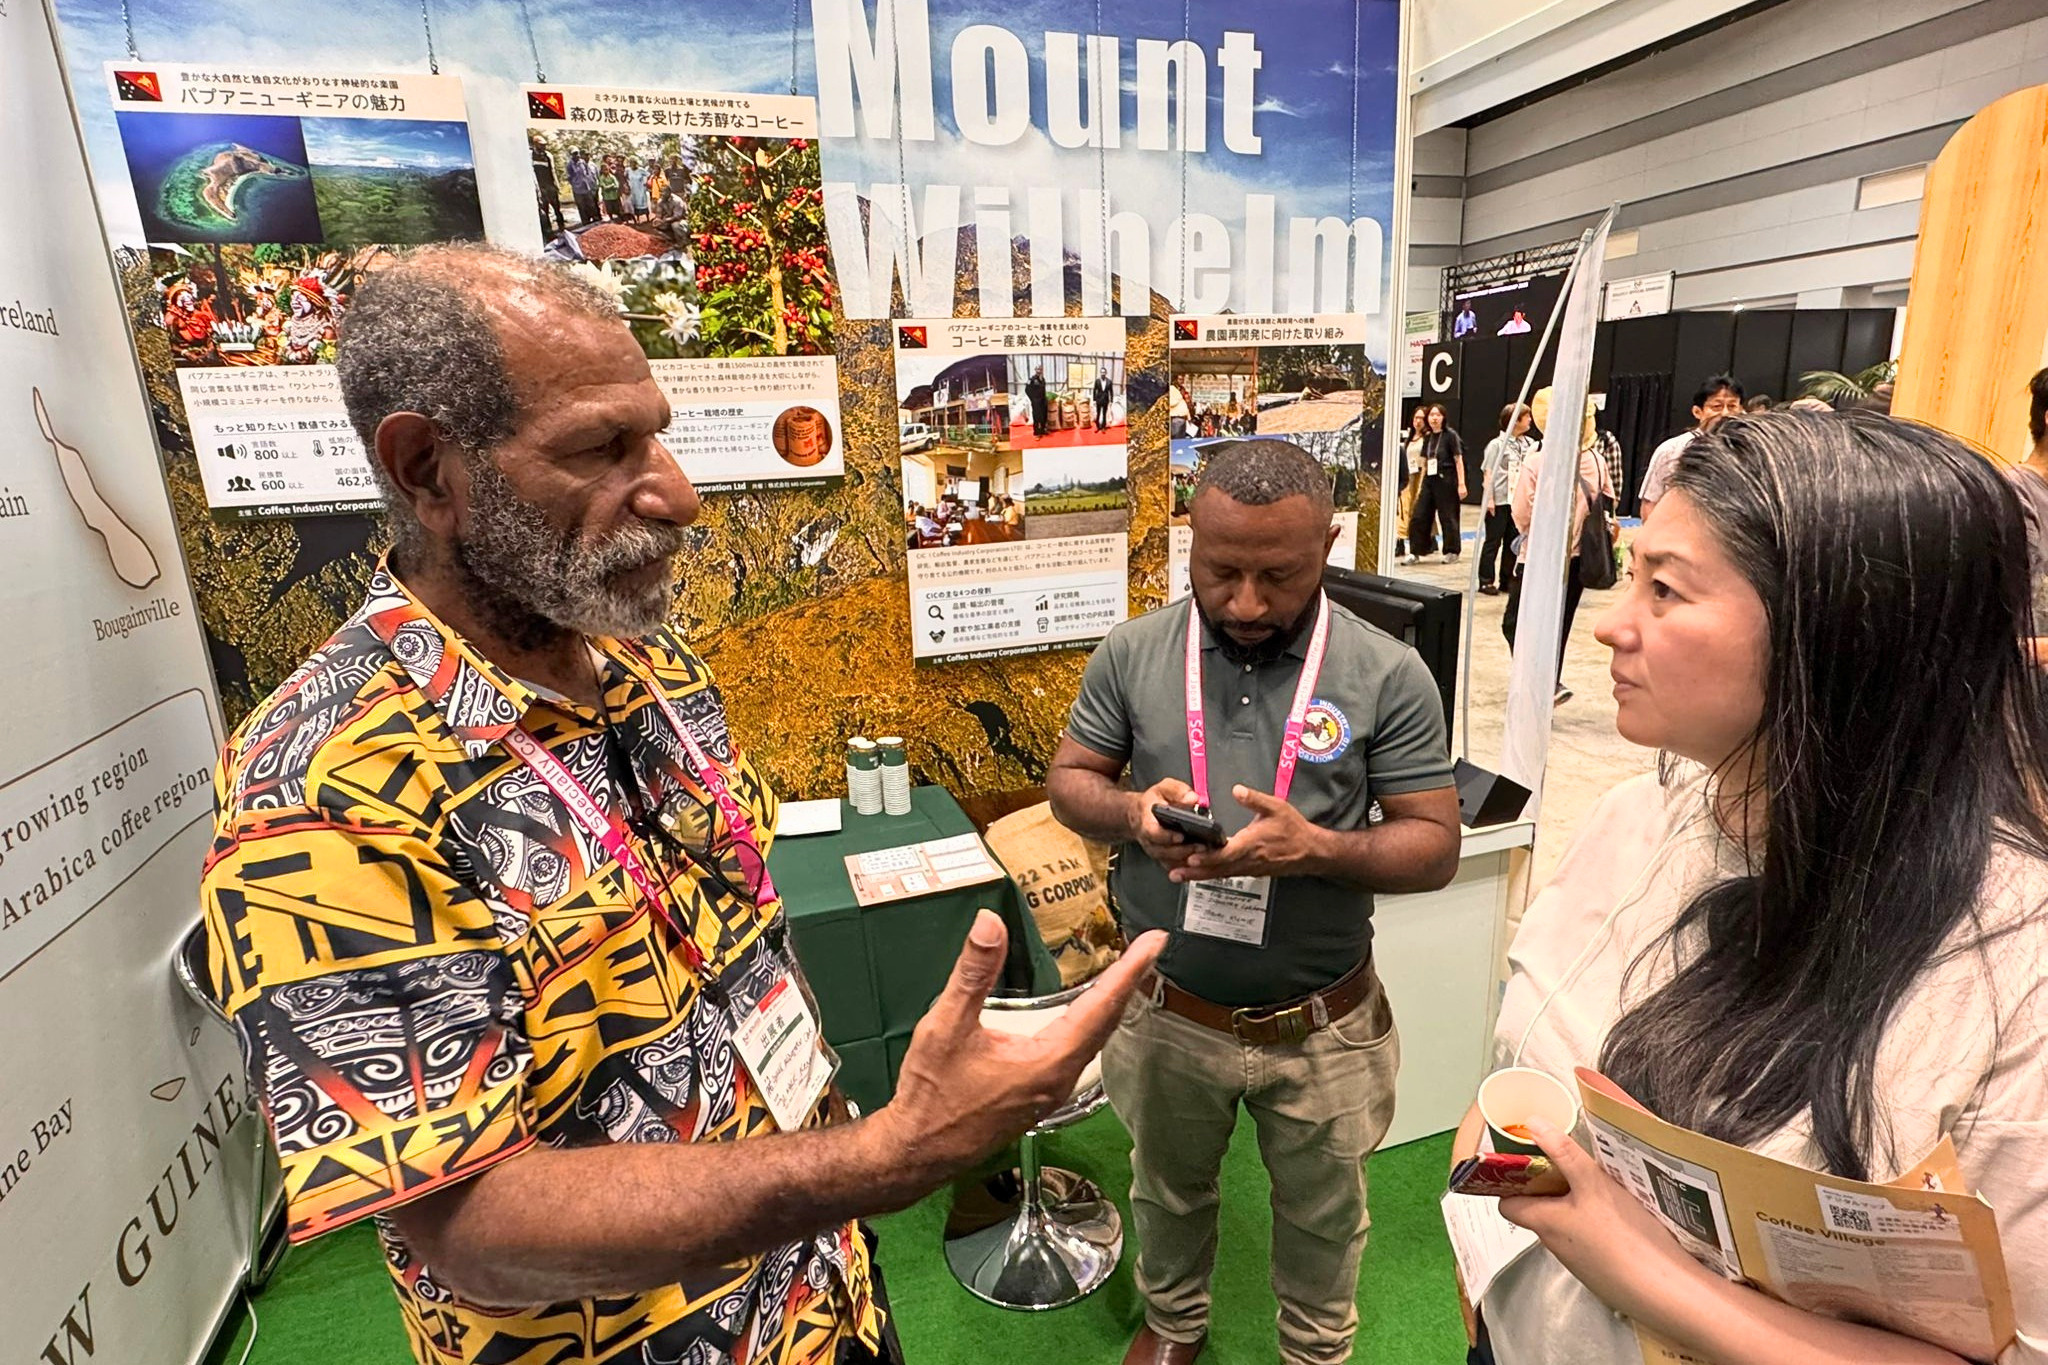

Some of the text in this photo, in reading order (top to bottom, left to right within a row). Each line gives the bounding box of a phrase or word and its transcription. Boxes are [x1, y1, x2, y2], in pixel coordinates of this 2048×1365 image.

[812, 0, 1262, 155] Mount
[181, 87, 406, 112] パプアニューギニアの魅力
[570, 106, 805, 130] 森の恵みを受けた芳醇なコーヒー
[820, 181, 1383, 321] Wilhelm
[0, 300, 59, 336] reland
[1205, 327, 1345, 342] 農園再開発に向けた取り組み
[1429, 351, 1454, 393] C
[254, 450, 279, 460] 800
[330, 446, 346, 456] 27
[261, 480, 286, 490] 600
[733, 482, 747, 491] Ltd
[257, 504, 291, 516] Coffee
[293, 504, 334, 517] Industry
[92, 597, 181, 641] Bougainville
[946, 652, 969, 662] Coffee
[969, 650, 998, 659] Industry
[1319, 699, 1349, 730] INDUSTRY
[1189, 719, 1206, 758] SCAJ
[1280, 730, 1299, 768] SCAJ
[91, 747, 149, 797] region
[537, 757, 605, 831] Specialty
[711, 780, 747, 833] SCAJ
[2, 766, 212, 930] Arabica coffee region
[612, 842, 658, 902] SCAJ
[1017, 868, 1041, 887] 22
[31, 1098, 72, 1154] Bay
[116, 1072, 252, 1288] GUINE
[1756, 1211, 1887, 1247] Coffee Village
